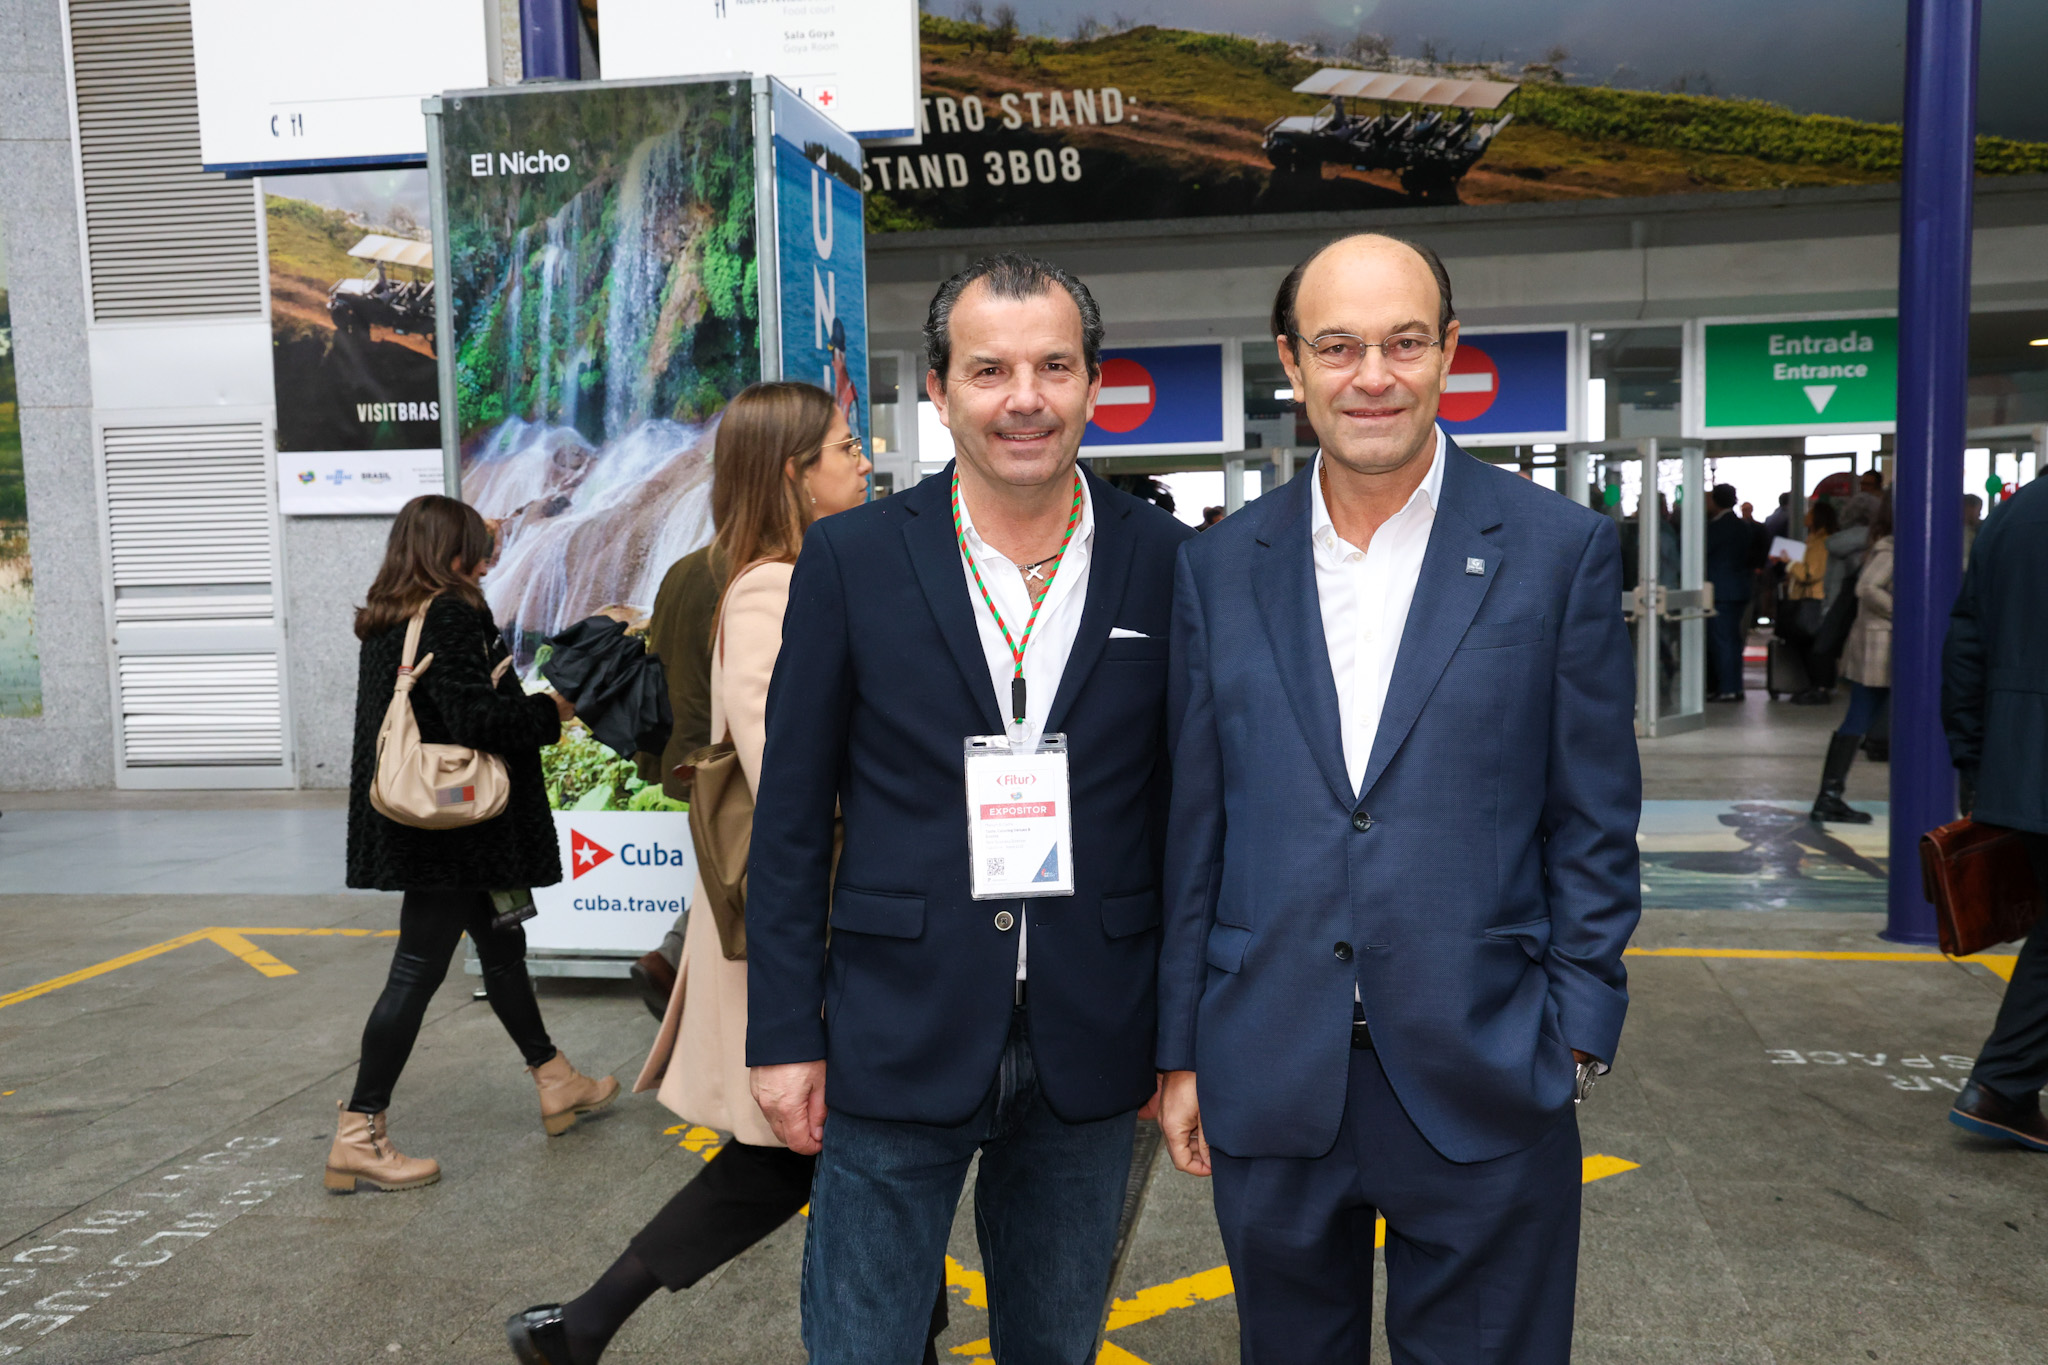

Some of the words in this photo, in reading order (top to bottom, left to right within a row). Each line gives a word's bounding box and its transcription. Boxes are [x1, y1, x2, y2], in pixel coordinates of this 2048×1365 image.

[784, 30, 805, 40] Sala
[808, 28, 835, 39] Goya
[783, 43, 808, 54] Goya
[811, 41, 838, 52] Room
[1000, 86, 1139, 130] STAND:
[471, 152, 493, 177] El
[499, 149, 571, 175] Nicho
[982, 146, 1082, 186] 3B08
[1768, 330, 1875, 356] Entrada
[1773, 362, 1869, 381] Entrance
[988, 805, 1048, 817] EXPOSITOR
[620, 842, 684, 867] Cuba
[573, 894, 686, 913] cuba.travel
